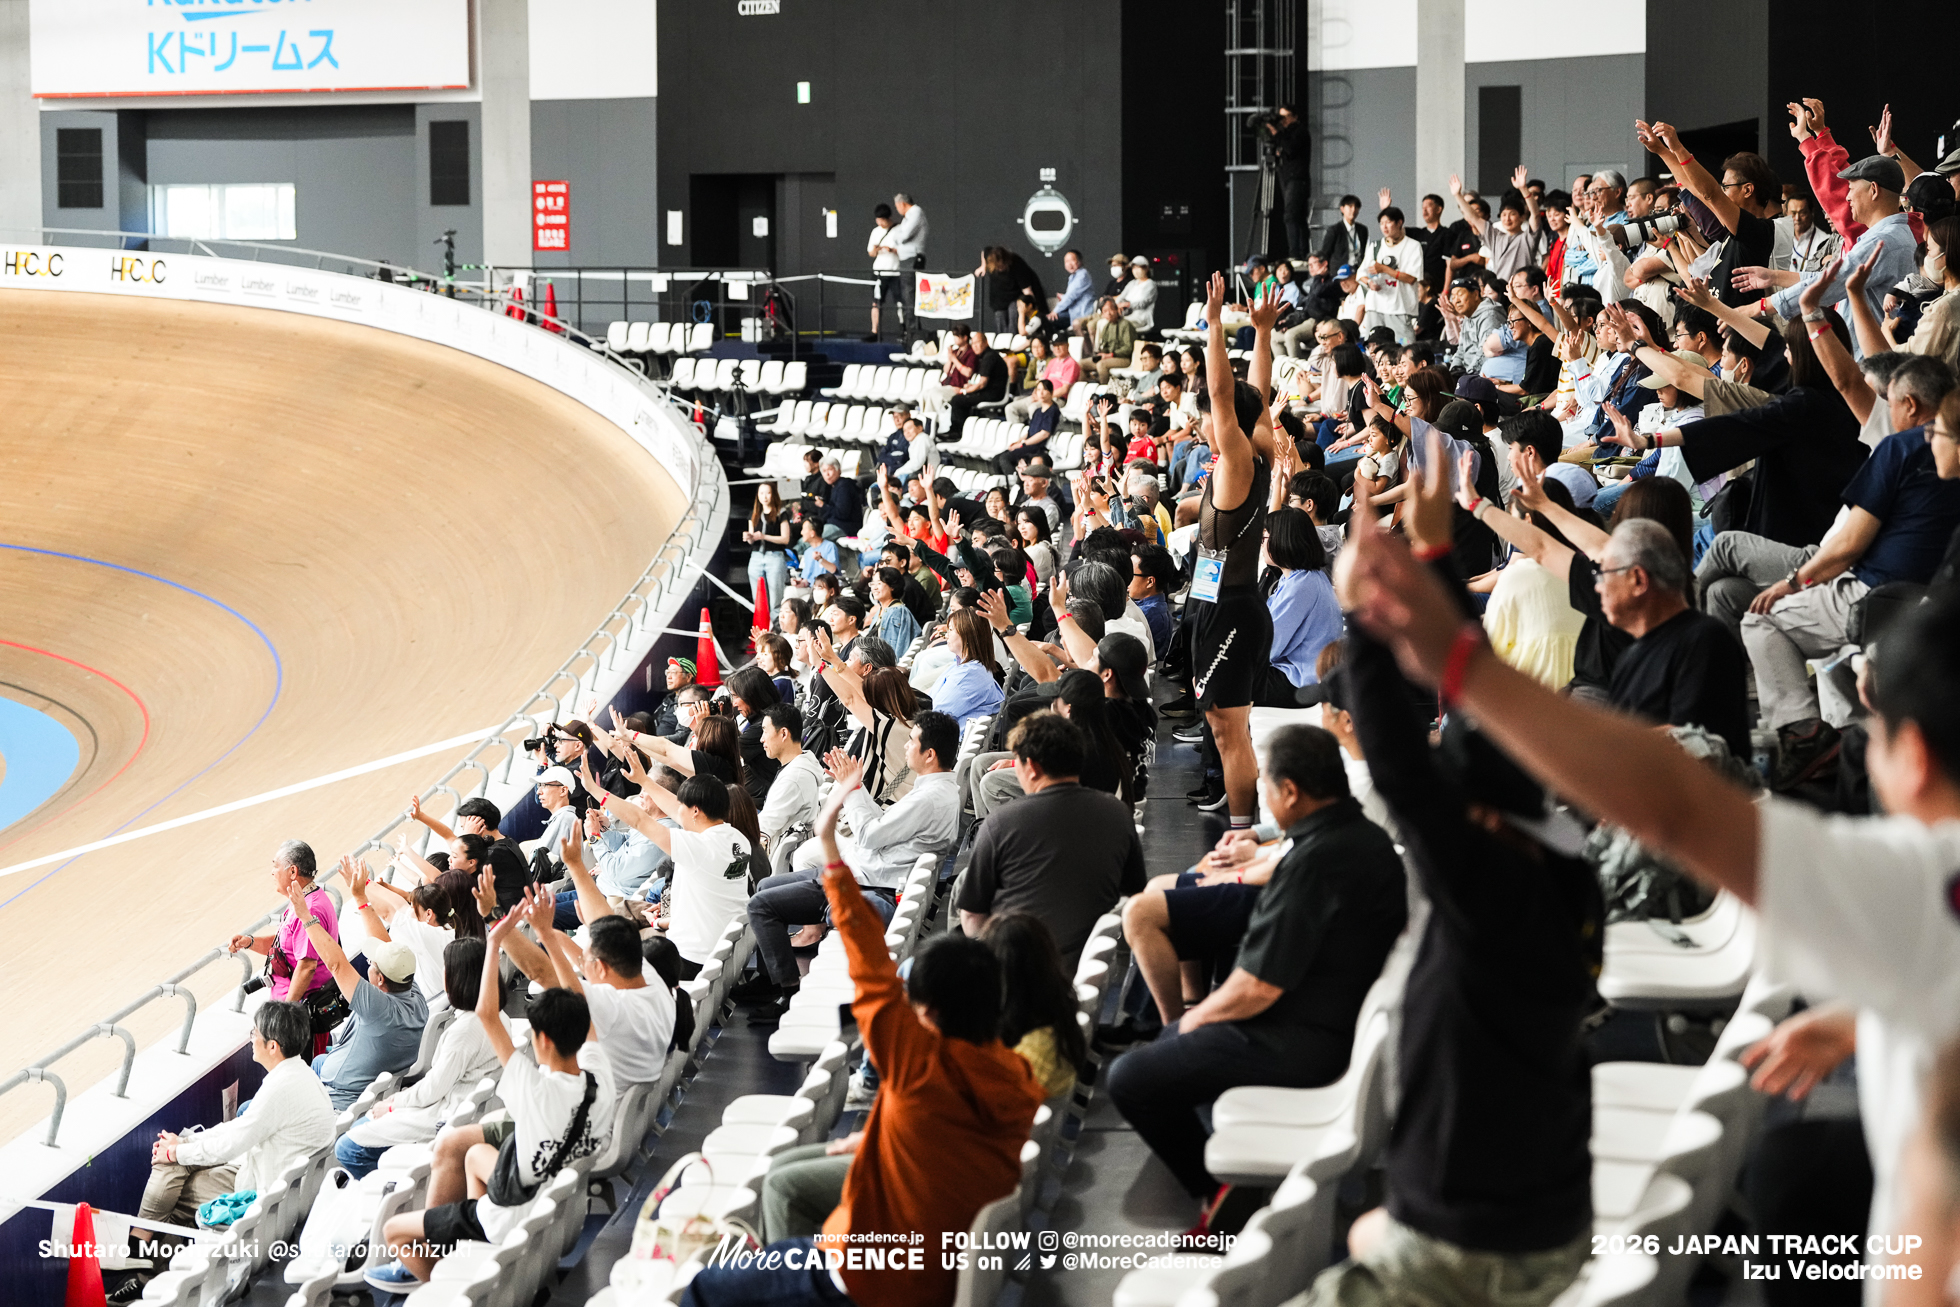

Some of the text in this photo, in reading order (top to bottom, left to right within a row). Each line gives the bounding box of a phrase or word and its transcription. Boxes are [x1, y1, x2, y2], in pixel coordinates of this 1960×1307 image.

[738, 0, 780, 16] CITIZEN
[148, 30, 339, 74] Kドリームス
[1195, 628, 1237, 699] Champion
